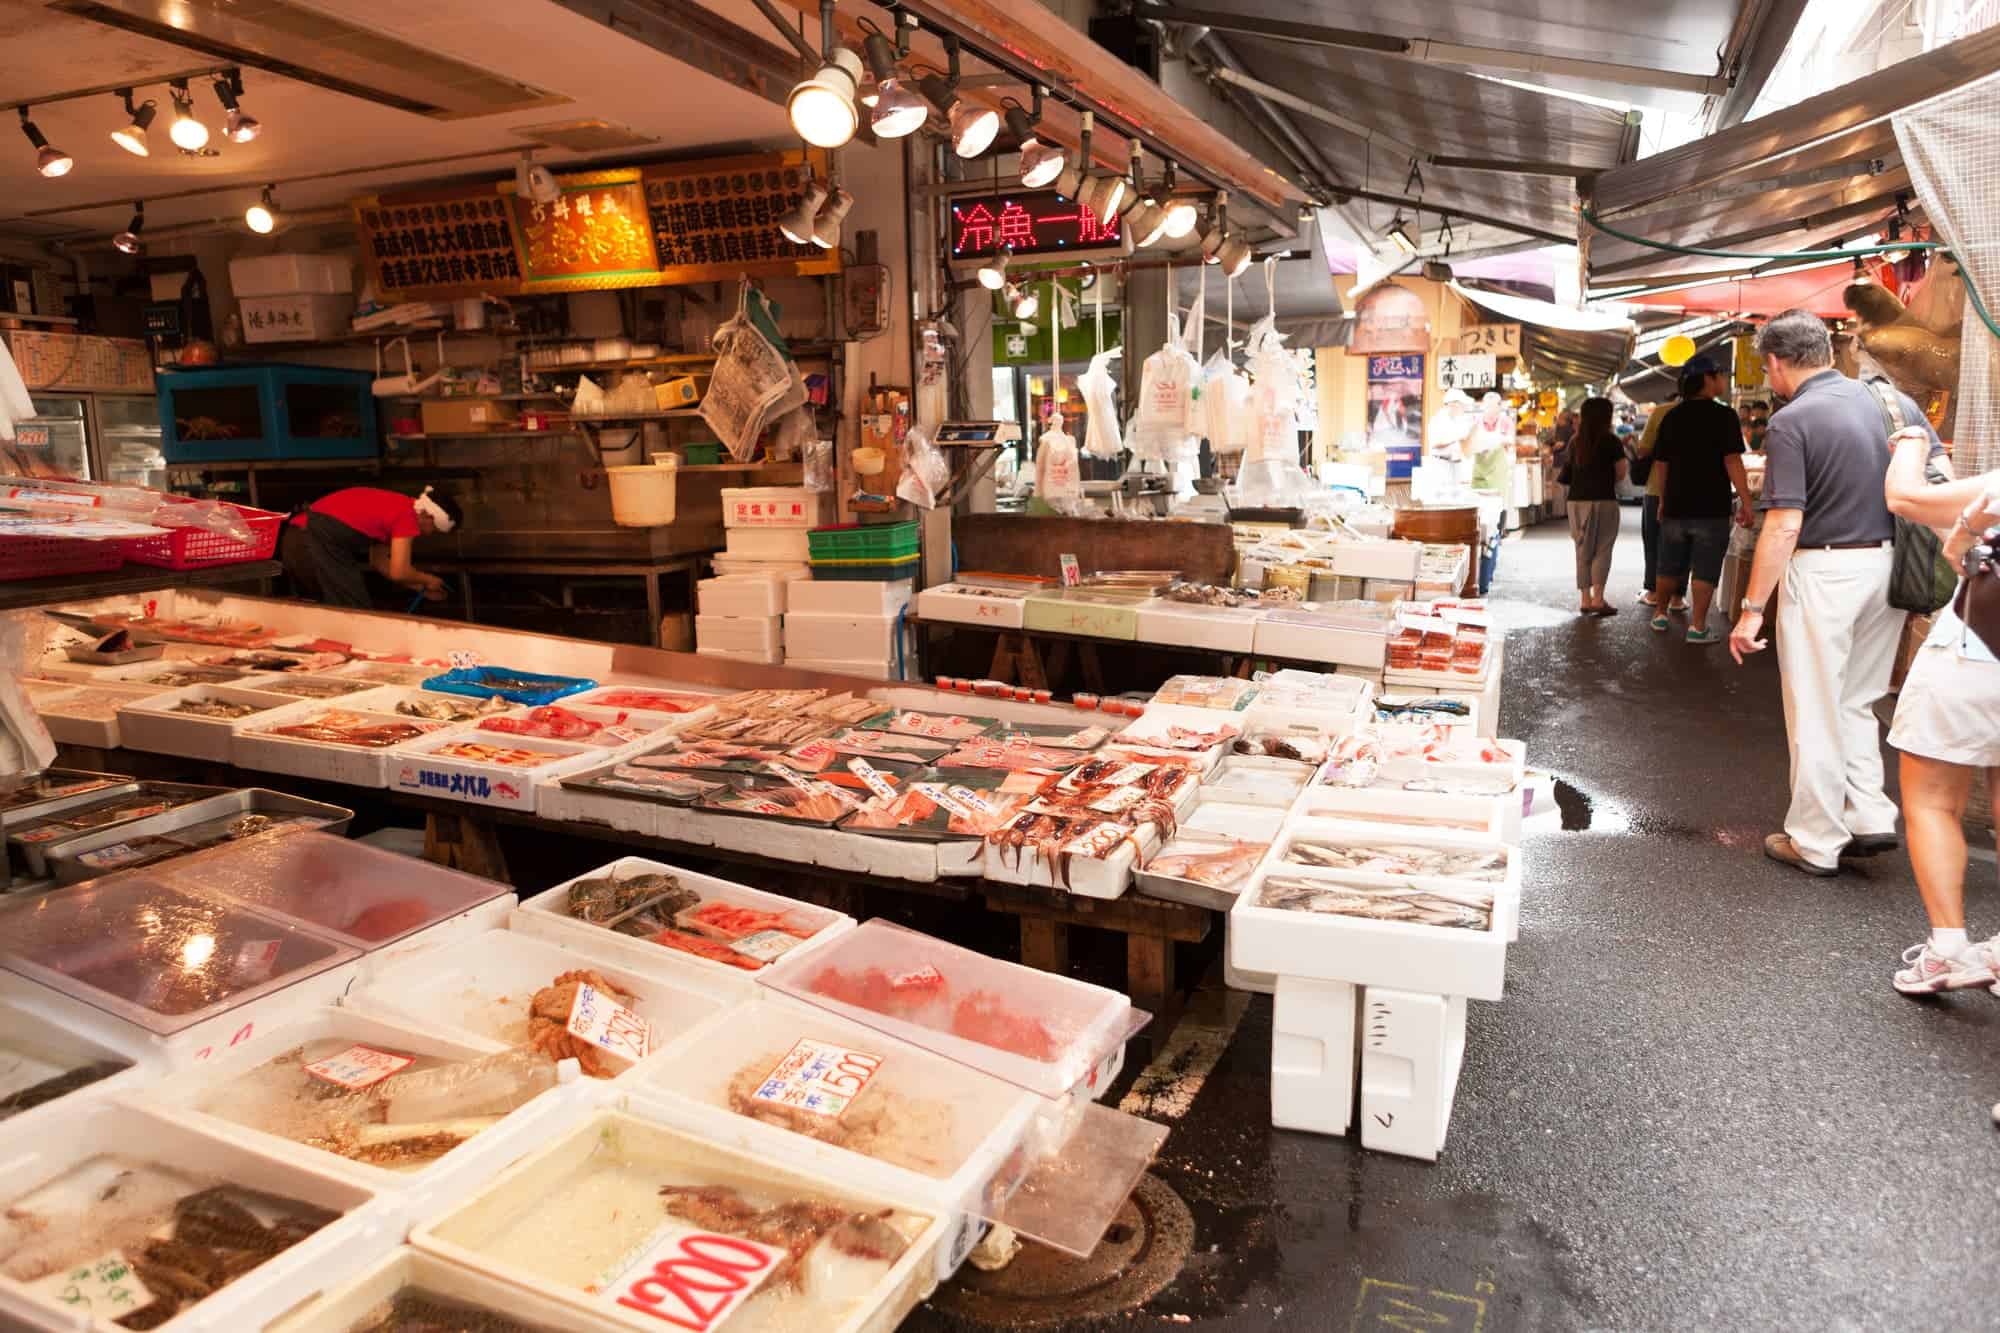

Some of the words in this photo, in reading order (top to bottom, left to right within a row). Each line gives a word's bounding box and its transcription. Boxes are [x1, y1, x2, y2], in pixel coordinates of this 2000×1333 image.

[1461, 327, 1516, 346] つきじ
[814, 1051, 884, 1098] 1500
[615, 1234, 771, 1333] 1200
